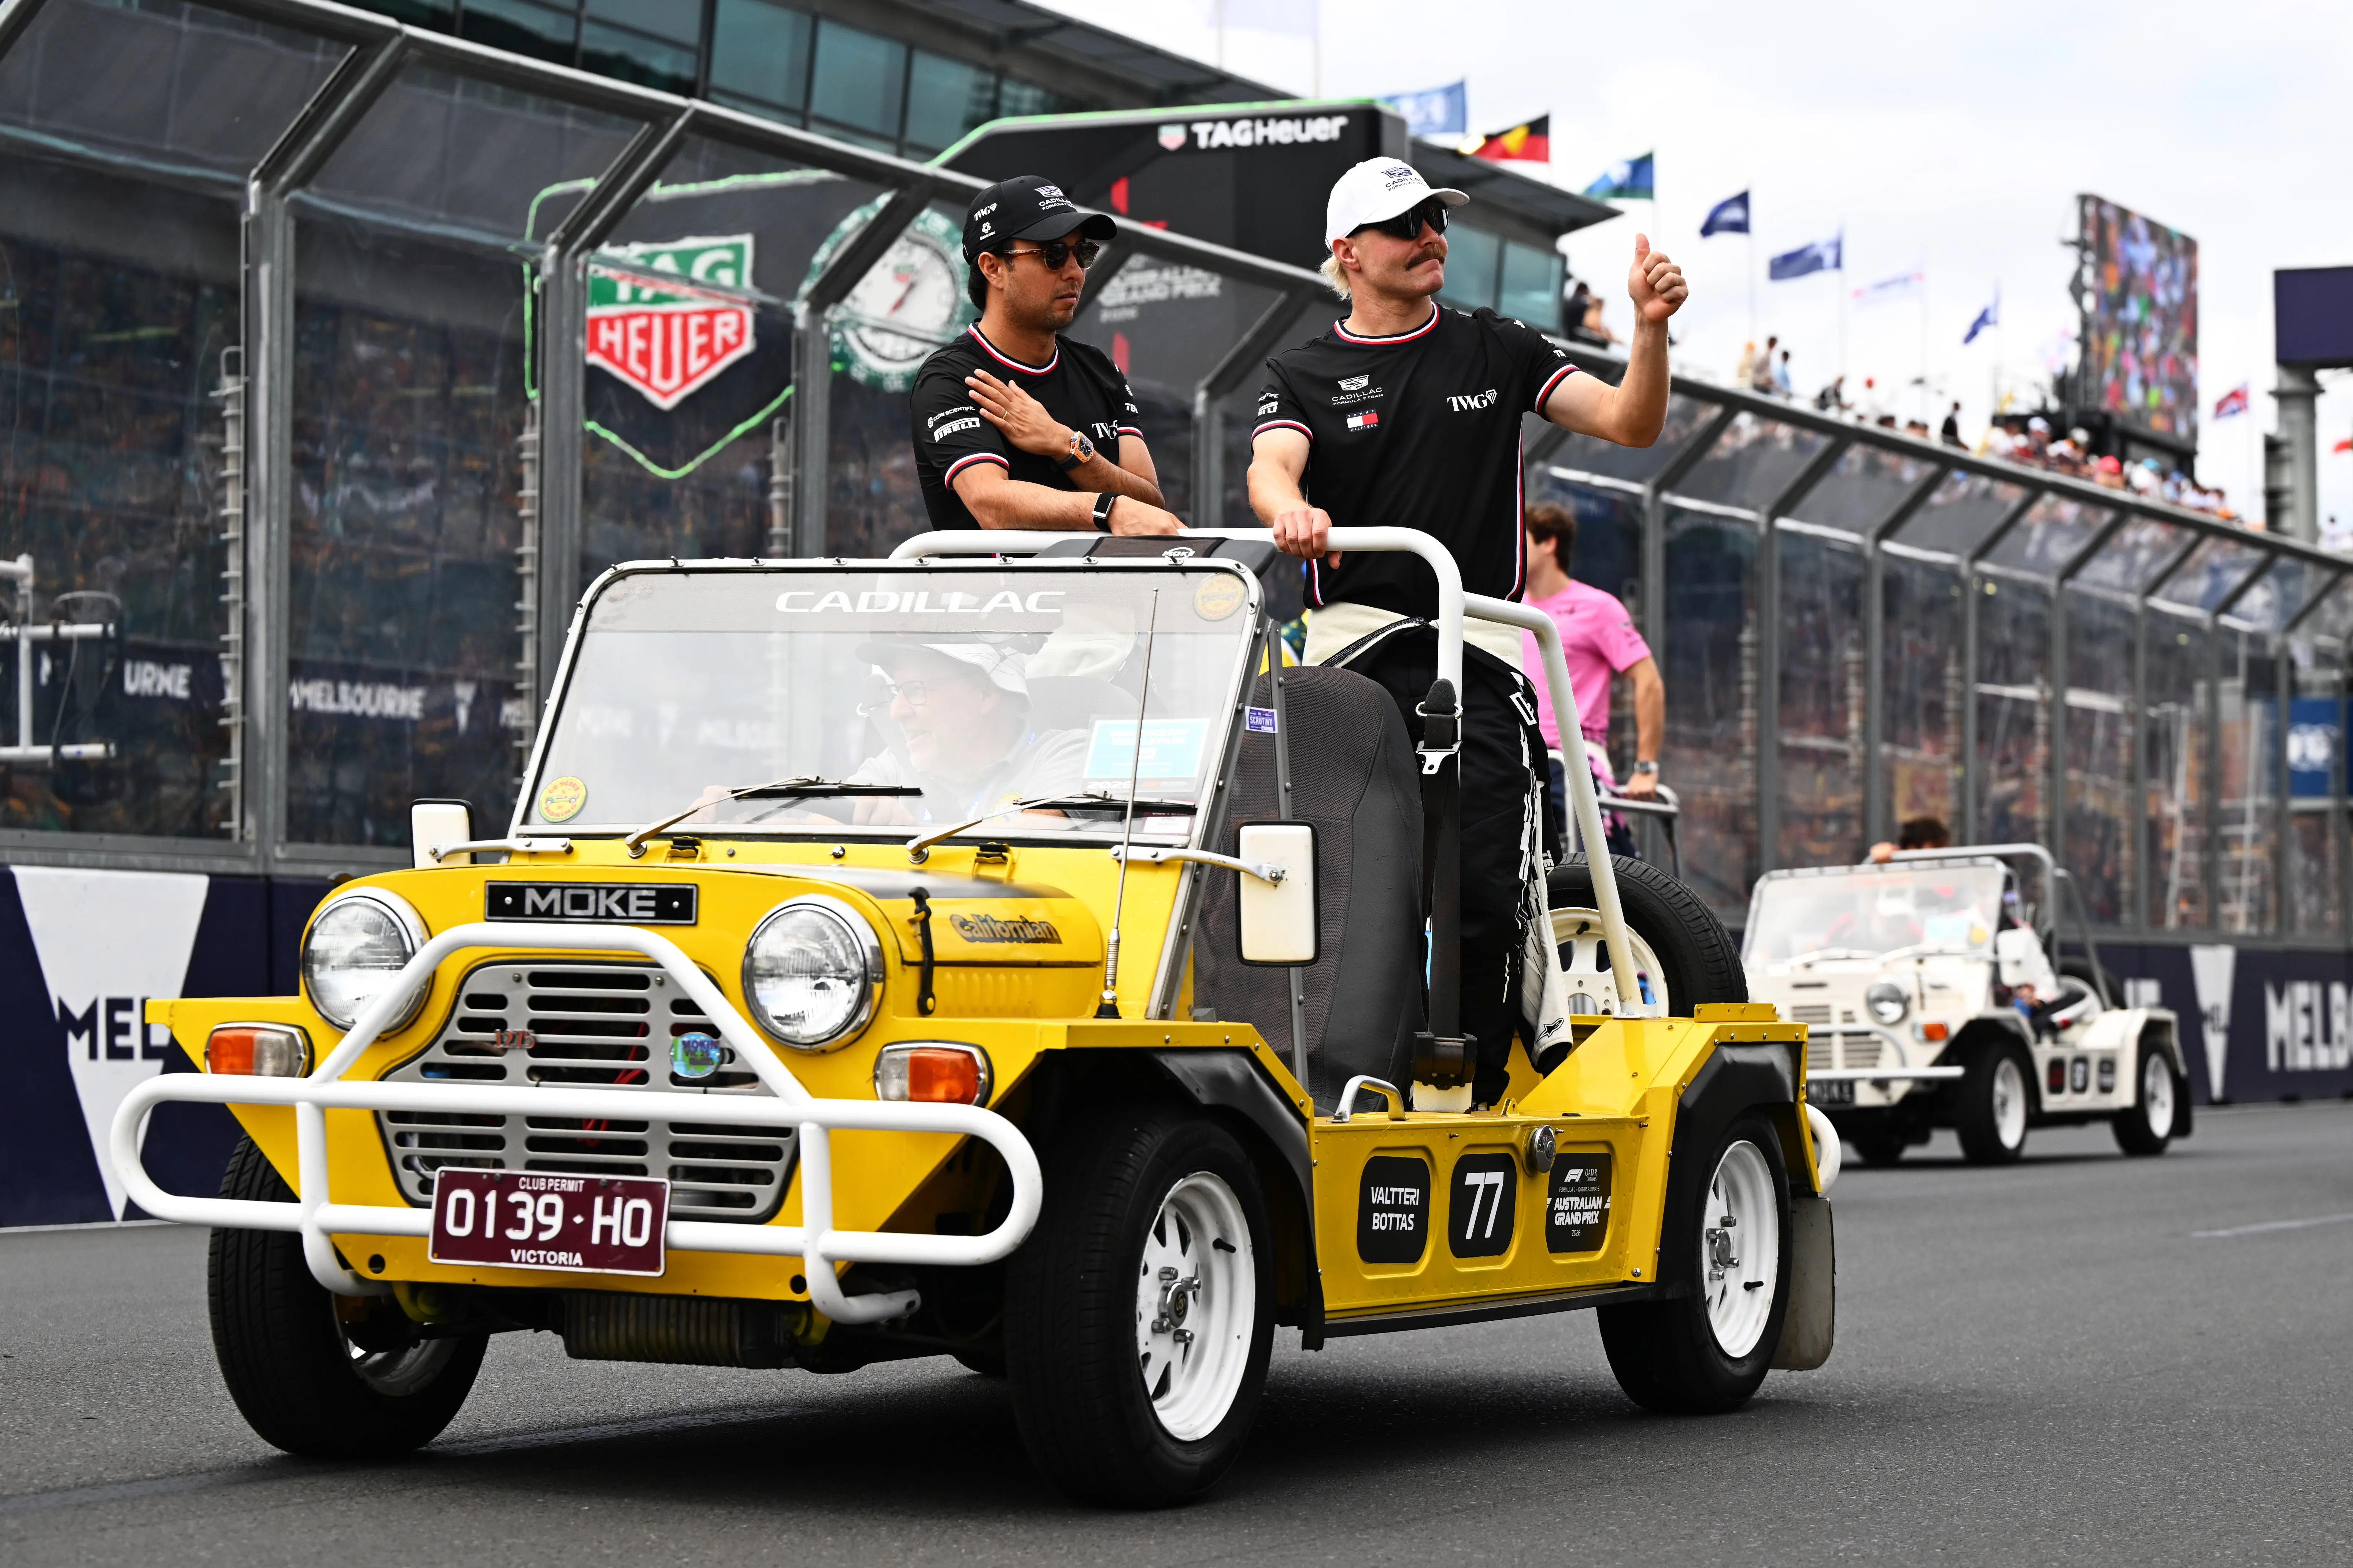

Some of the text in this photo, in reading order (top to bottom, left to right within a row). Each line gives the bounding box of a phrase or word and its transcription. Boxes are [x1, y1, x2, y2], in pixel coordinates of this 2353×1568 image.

[1388, 182, 1412, 191] FORMULA
[974, 207, 991, 221] TWG
[980, 231, 995, 240] Banamex
[599, 311, 740, 391] HEUER
[1332, 387, 1383, 401] CADILLAC
[1447, 394, 1488, 412] TWG
[1348, 409, 1374, 418] TOMMY
[934, 417, 981, 442] PIRELLI
[1351, 424, 1377, 432] HILFIGER
[775, 591, 1066, 613] CADILLAC
[289, 679, 426, 720] MELBOURNE
[1250, 716, 1273, 726] SCRUTINY
[524, 888, 656, 917] MOKE
[950, 914, 1062, 944] Californian
[2265, 979, 2353, 1070] MELB
[1585, 1169, 1597, 1177] QATAR
[519, 1177, 585, 1193] CLUB PERMIT
[1371, 1186, 1420, 1205] VALTTERI
[1554, 1196, 1602, 1211] AUSTRALIAN
[1465, 1172, 1504, 1239] 77
[1372, 1213, 1414, 1231] BOTTAS
[1555, 1211, 1599, 1225] GRAND PRIX
[511, 1249, 583, 1266] VICTORIA
